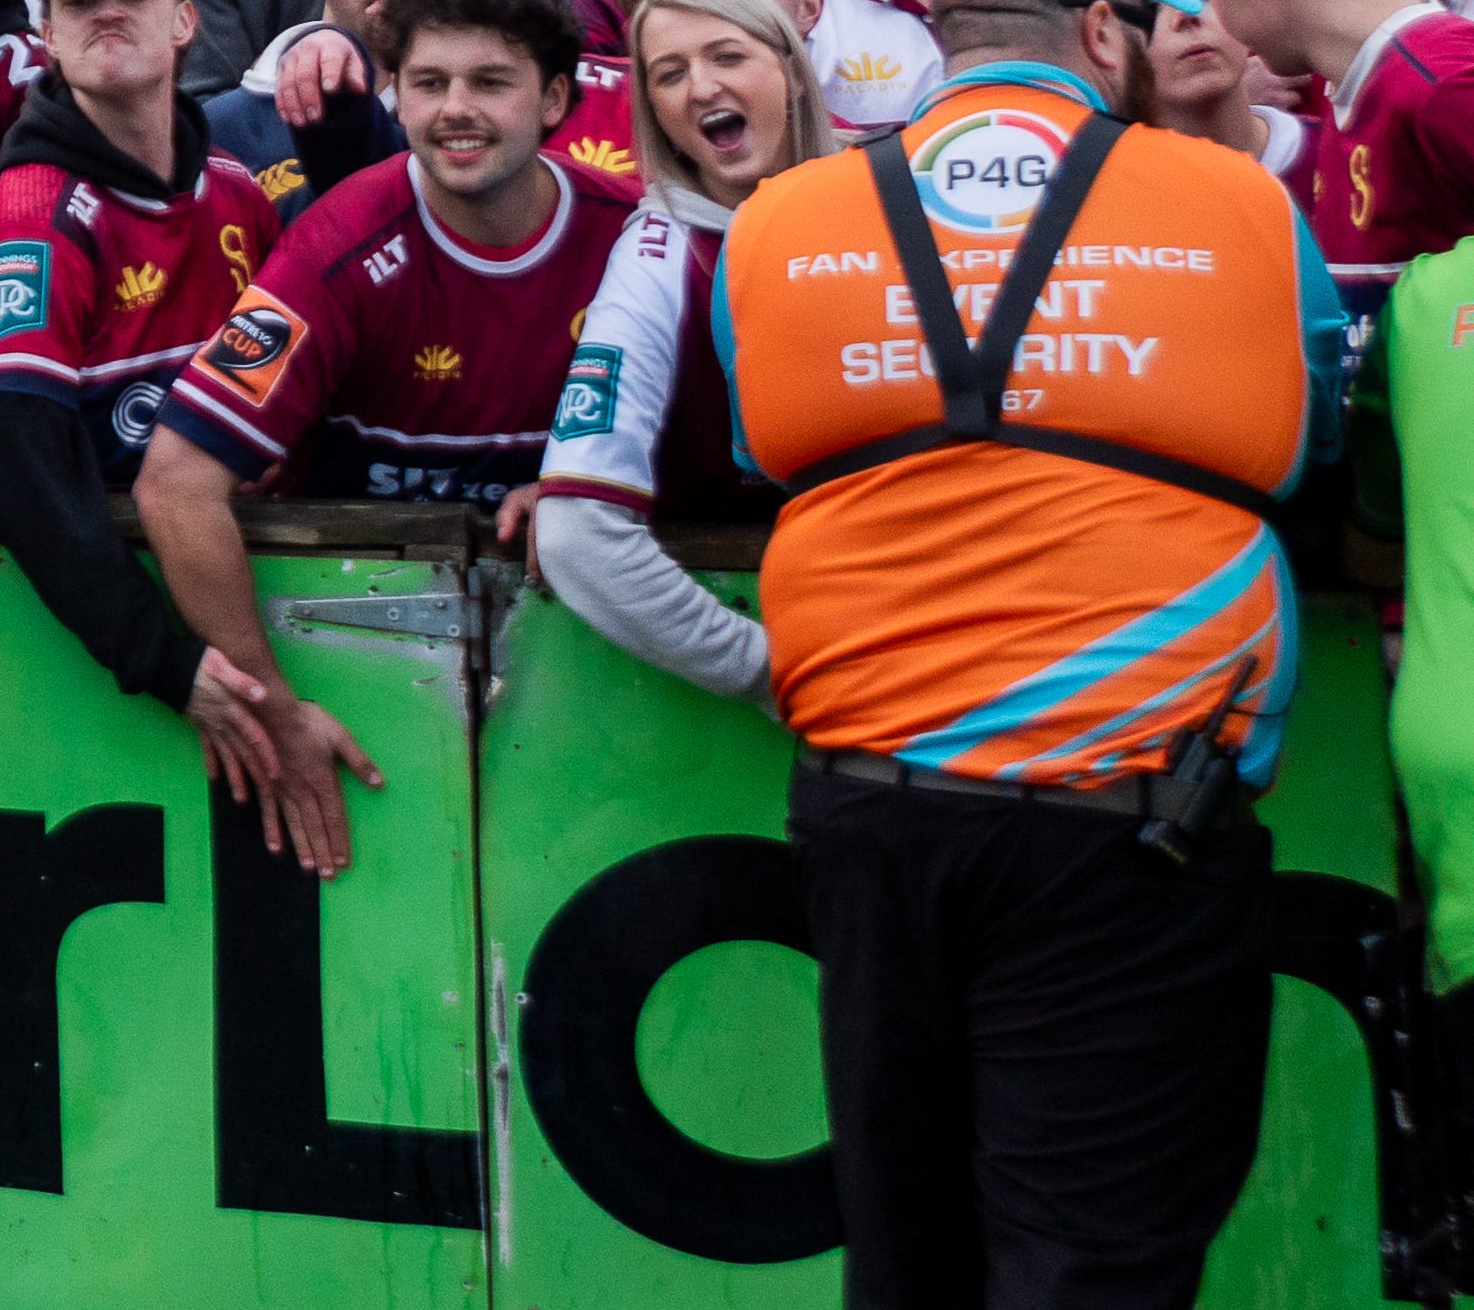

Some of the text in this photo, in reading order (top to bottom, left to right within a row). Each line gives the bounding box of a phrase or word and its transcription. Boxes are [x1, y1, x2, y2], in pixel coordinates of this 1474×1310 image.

[945, 153, 1049, 192] P4G
[786, 250, 878, 280] FAN
[222, 327, 263, 357] CUP
